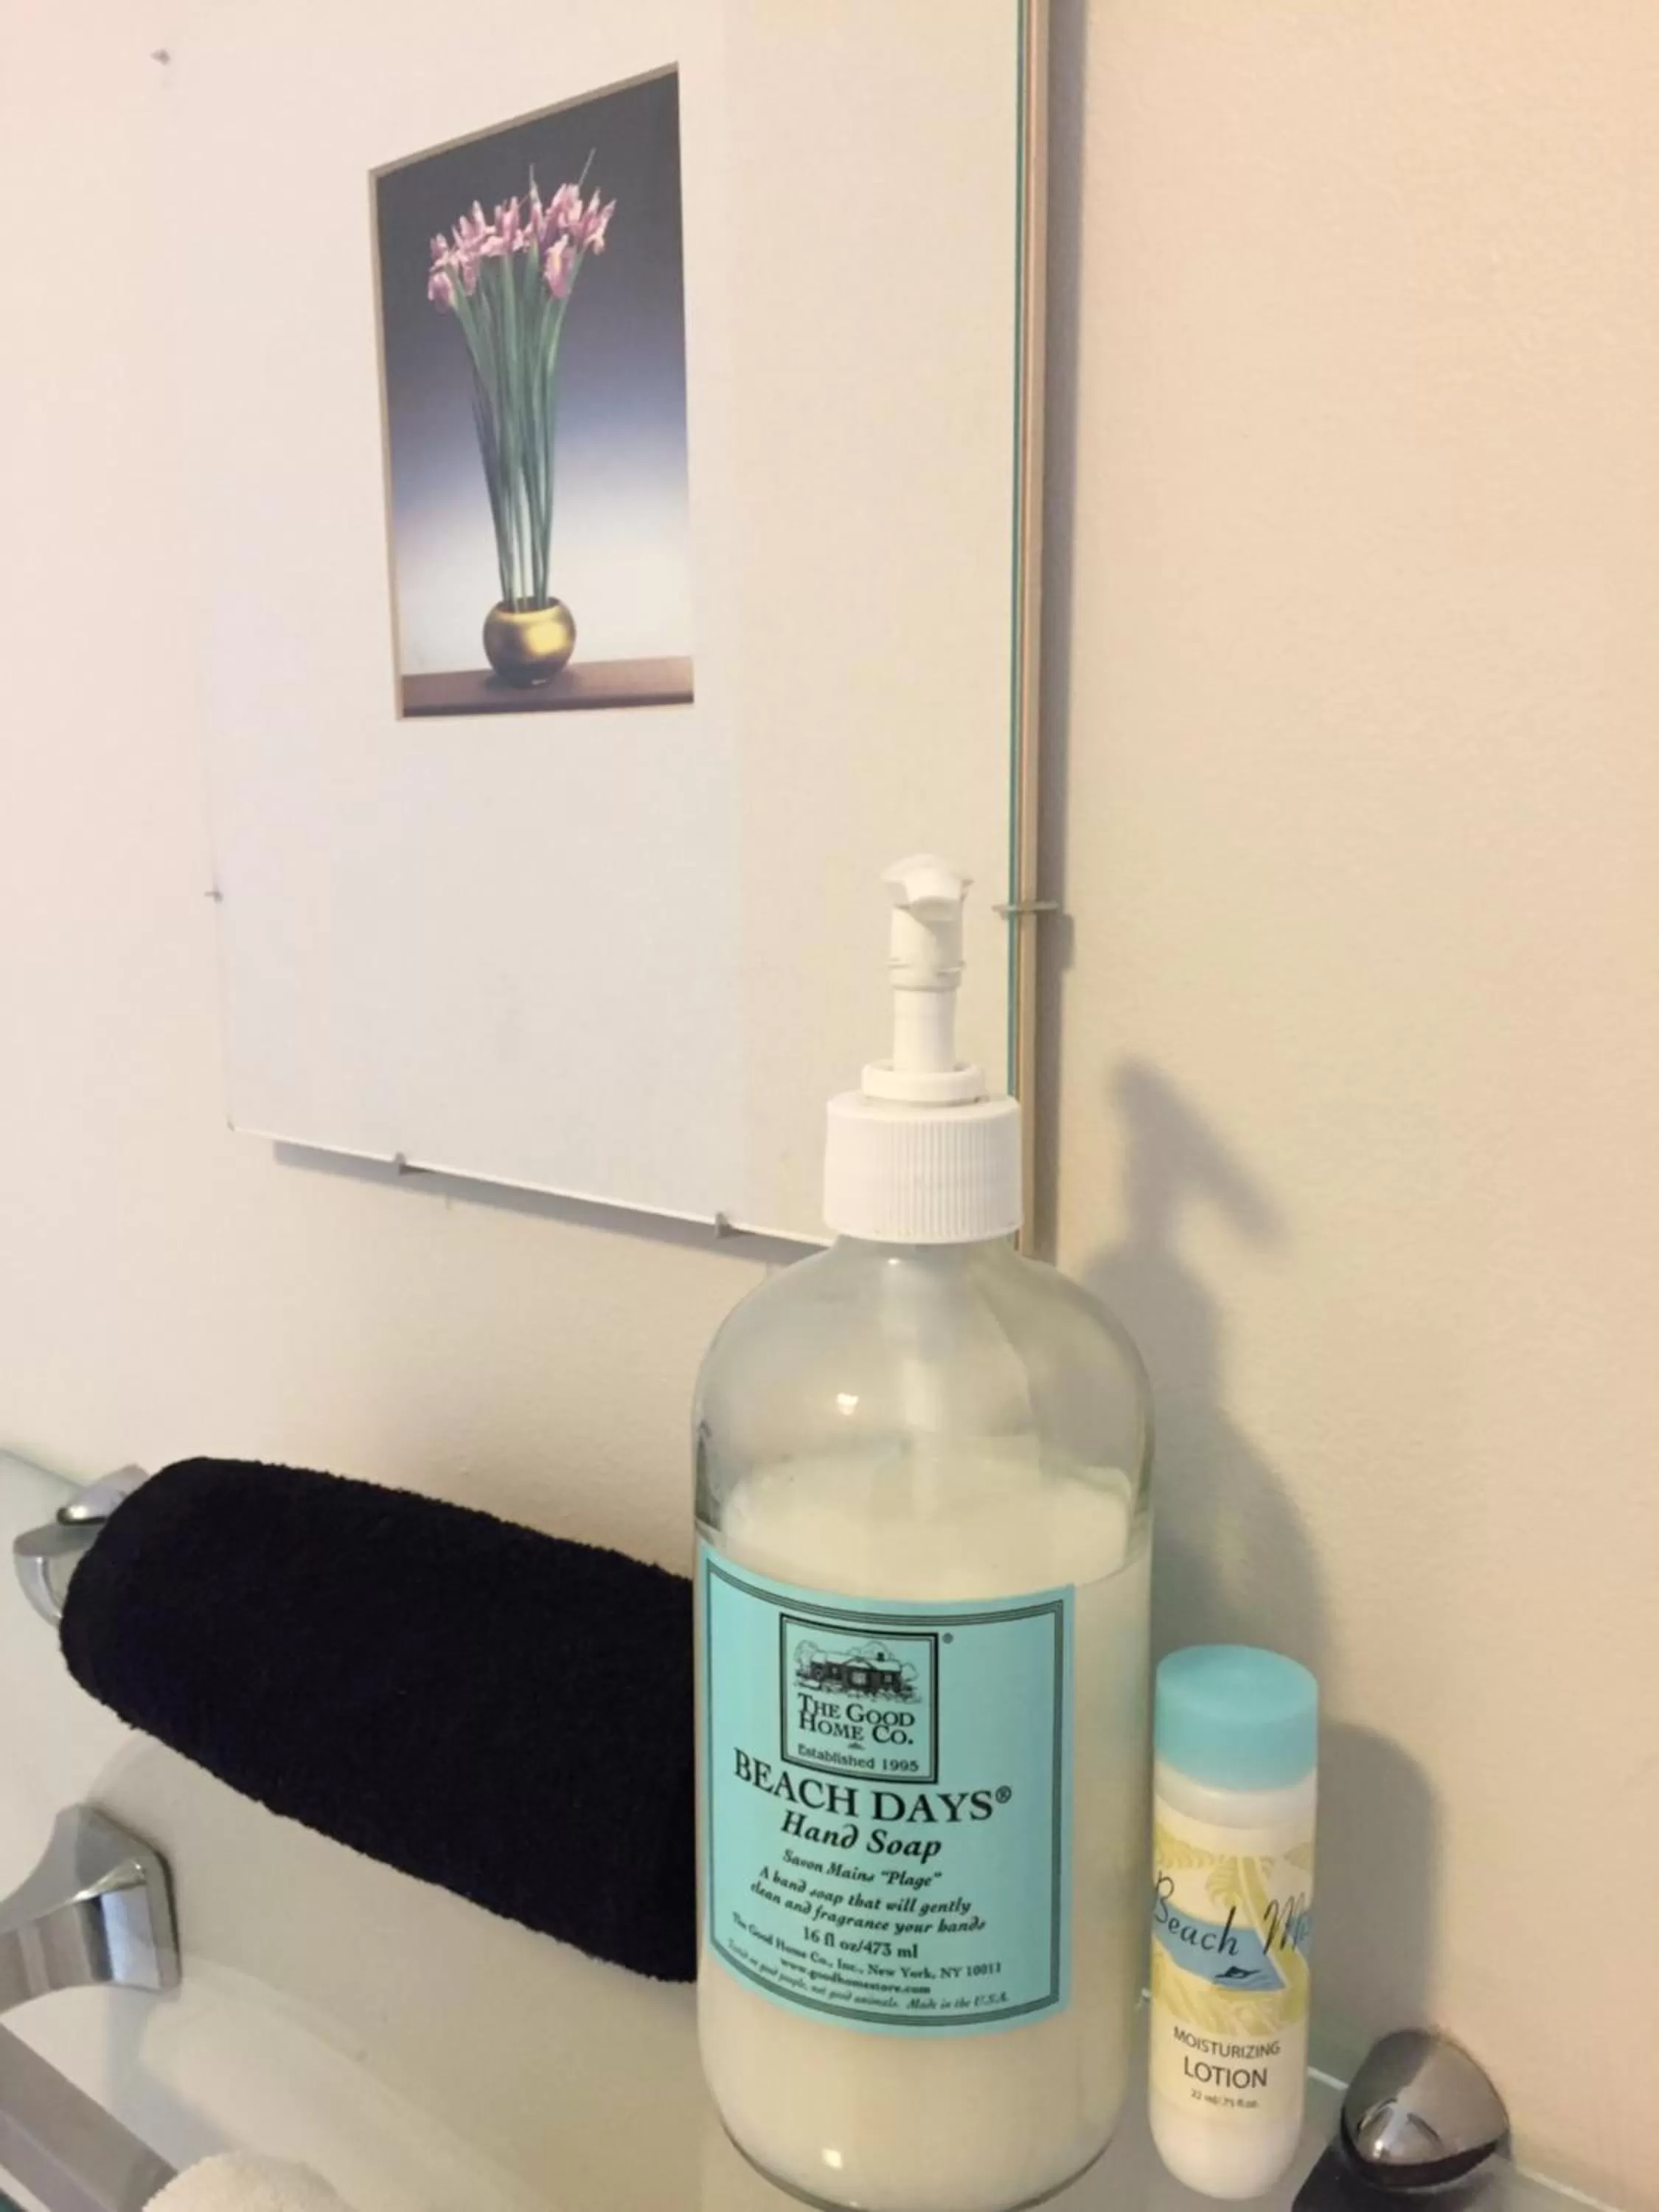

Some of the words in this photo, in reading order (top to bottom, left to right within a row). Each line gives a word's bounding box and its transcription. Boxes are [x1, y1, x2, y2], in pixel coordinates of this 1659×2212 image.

[797, 1743, 875, 1770] Established
[882, 1759, 919, 1773] 1995
[734, 1747, 859, 1818] BEACH
[780, 1809, 859, 1849] Hand
[866, 1829, 942, 1864] Soap
[782, 1848, 824, 1873] Savon
[826, 1861, 875, 1882] Mains
[750, 1879, 781, 1905] clean
[784, 1899, 813, 1915] and
[812, 1904, 890, 1931] fragrance
[893, 1921, 933, 1936] your
[936, 1915, 987, 1933] hands
[759, 1865, 769, 1879] A
[772, 1870, 807, 1893] hand
[809, 1888, 844, 1907] soap
[847, 1891, 882, 1910] that
[886, 1896, 918, 1913] will
[918, 1896, 972, 1917] gently
[1152, 1870, 1239, 1957] Beach
[804, 1925, 821, 1944] 16
[824, 1931, 835, 1947] fl
[839, 1938, 892, 1957] oz/473
[897, 1943, 919, 1959] ml
[867, 1964, 895, 1977] New
[900, 1966, 936, 1980] York,
[939, 1966, 963, 1979] NY
[1173, 2025, 1281, 2059] MOISTURIZING
[1183, 2055, 1268, 2090] LOTION
